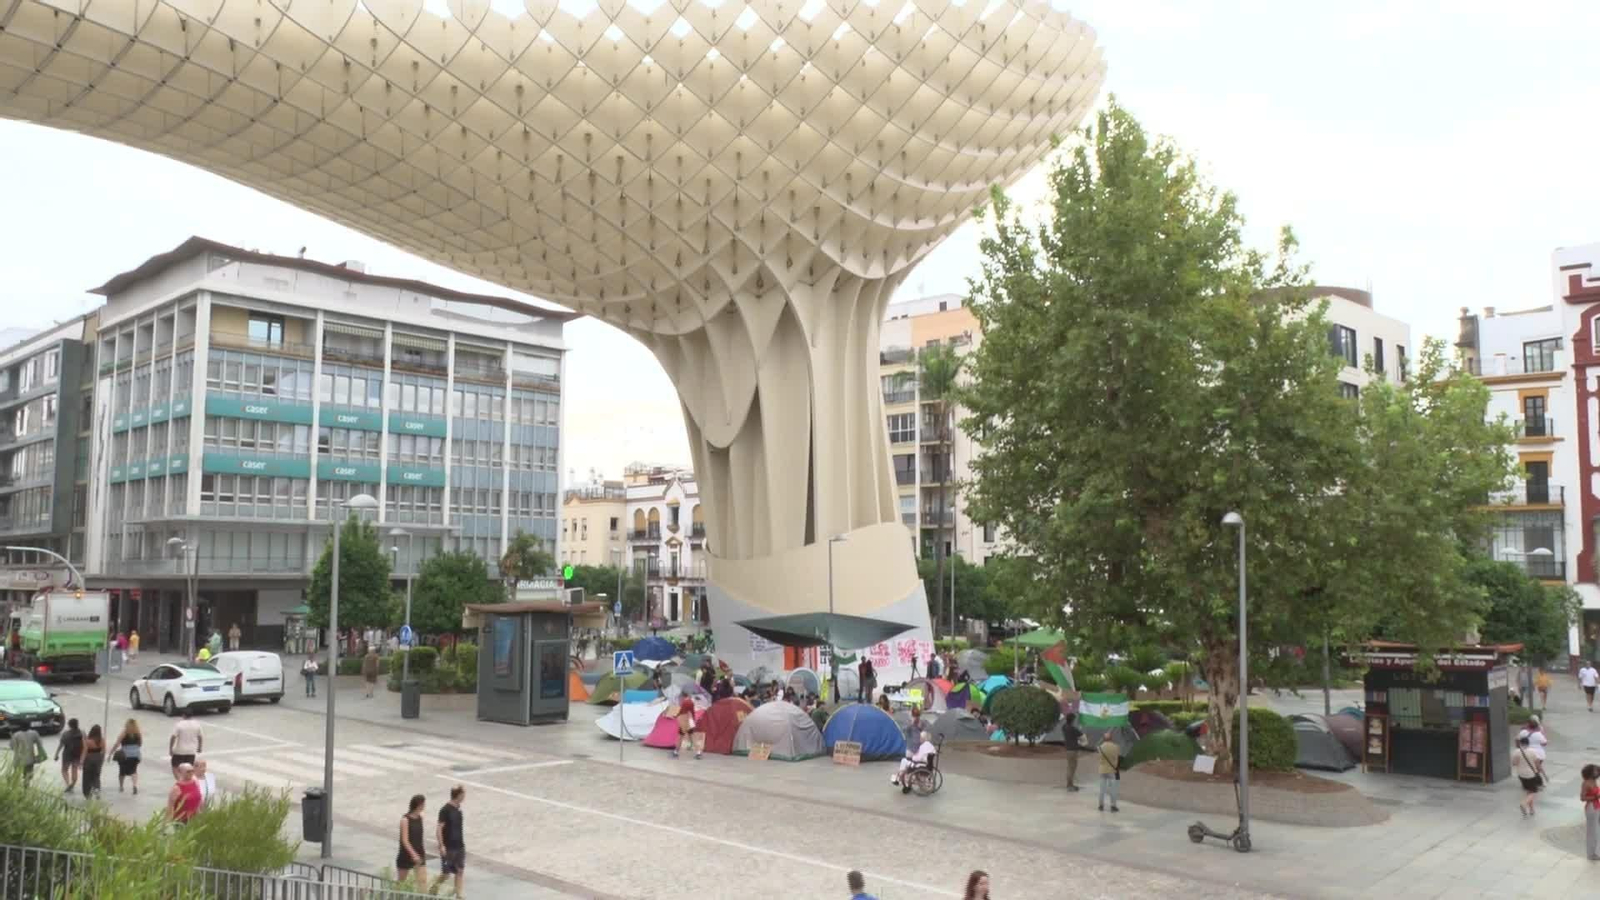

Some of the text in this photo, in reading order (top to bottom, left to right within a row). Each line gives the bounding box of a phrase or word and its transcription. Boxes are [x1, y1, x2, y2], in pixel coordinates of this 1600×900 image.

[245, 405, 268, 414] caser
[337, 415, 359, 423] caser
[405, 421, 424, 430] caser
[242, 460, 267, 470] caser
[335, 467, 357, 475] caser
[403, 472, 423, 480] caser
[516, 579, 555, 589] RMACIA
[1453, 659, 1487, 667] Estado
